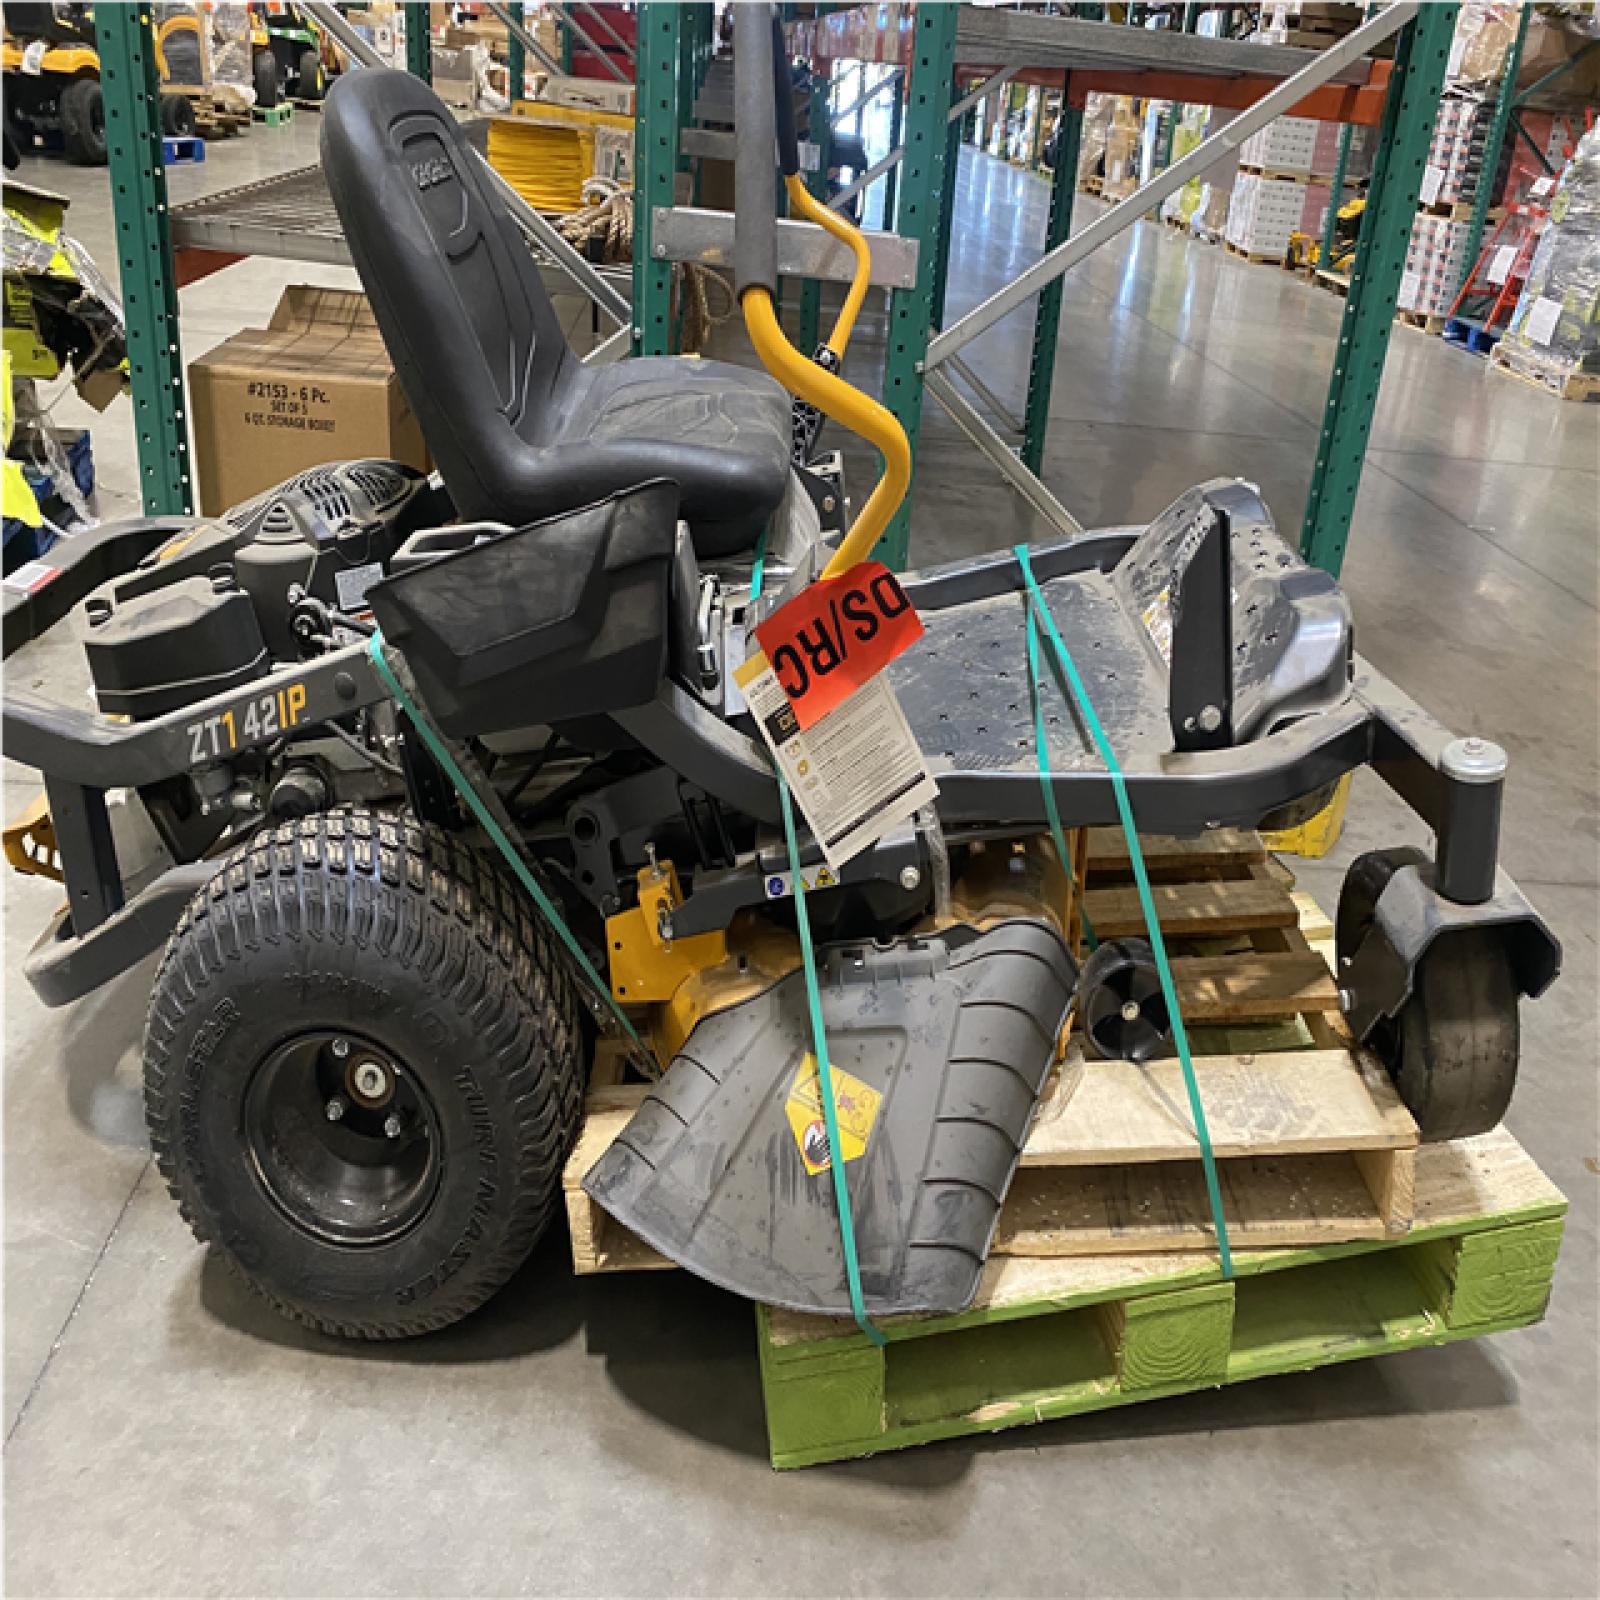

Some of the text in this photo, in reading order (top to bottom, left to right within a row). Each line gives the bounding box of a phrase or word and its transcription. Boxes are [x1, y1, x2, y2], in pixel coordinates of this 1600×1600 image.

[248, 382, 288, 399] #2153
[300, 385, 308, 401] 6
[773, 572, 910, 698] DS/RC
[187, 709, 236, 763] ZT1
